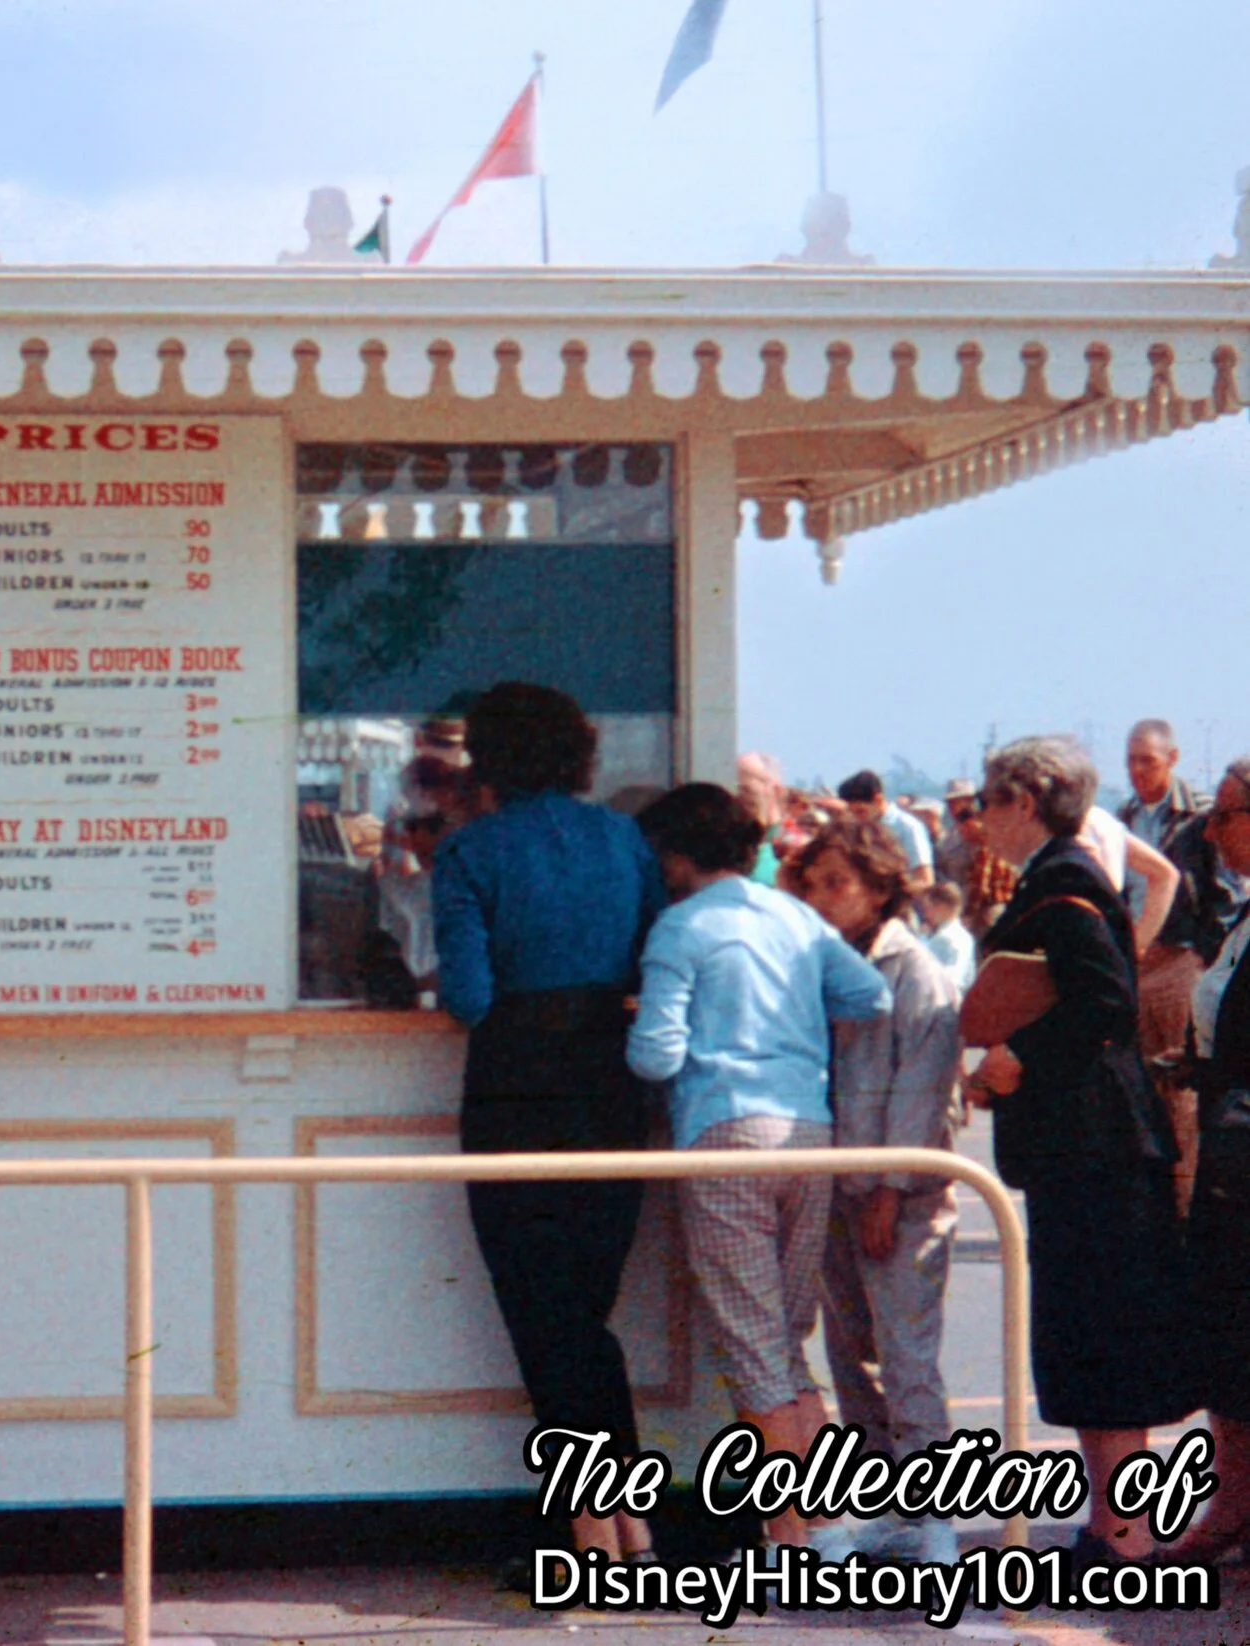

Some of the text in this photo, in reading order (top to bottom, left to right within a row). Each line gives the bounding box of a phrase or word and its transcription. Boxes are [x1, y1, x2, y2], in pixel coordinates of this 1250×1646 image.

[94, 481, 226, 506] ADMISSION
[11, 649, 78, 672] BONUS
[88, 648, 171, 672] COUPON
[181, 647, 242, 671] BOOK
[34, 819, 63, 842] AT
[78, 818, 228, 842] DISNEYLAND
[46, 985, 60, 1000] IN
[66, 985, 137, 1001] UNIFORM
[146, 986, 158, 1001] &
[164, 984, 265, 1000] CLERGYMEN
